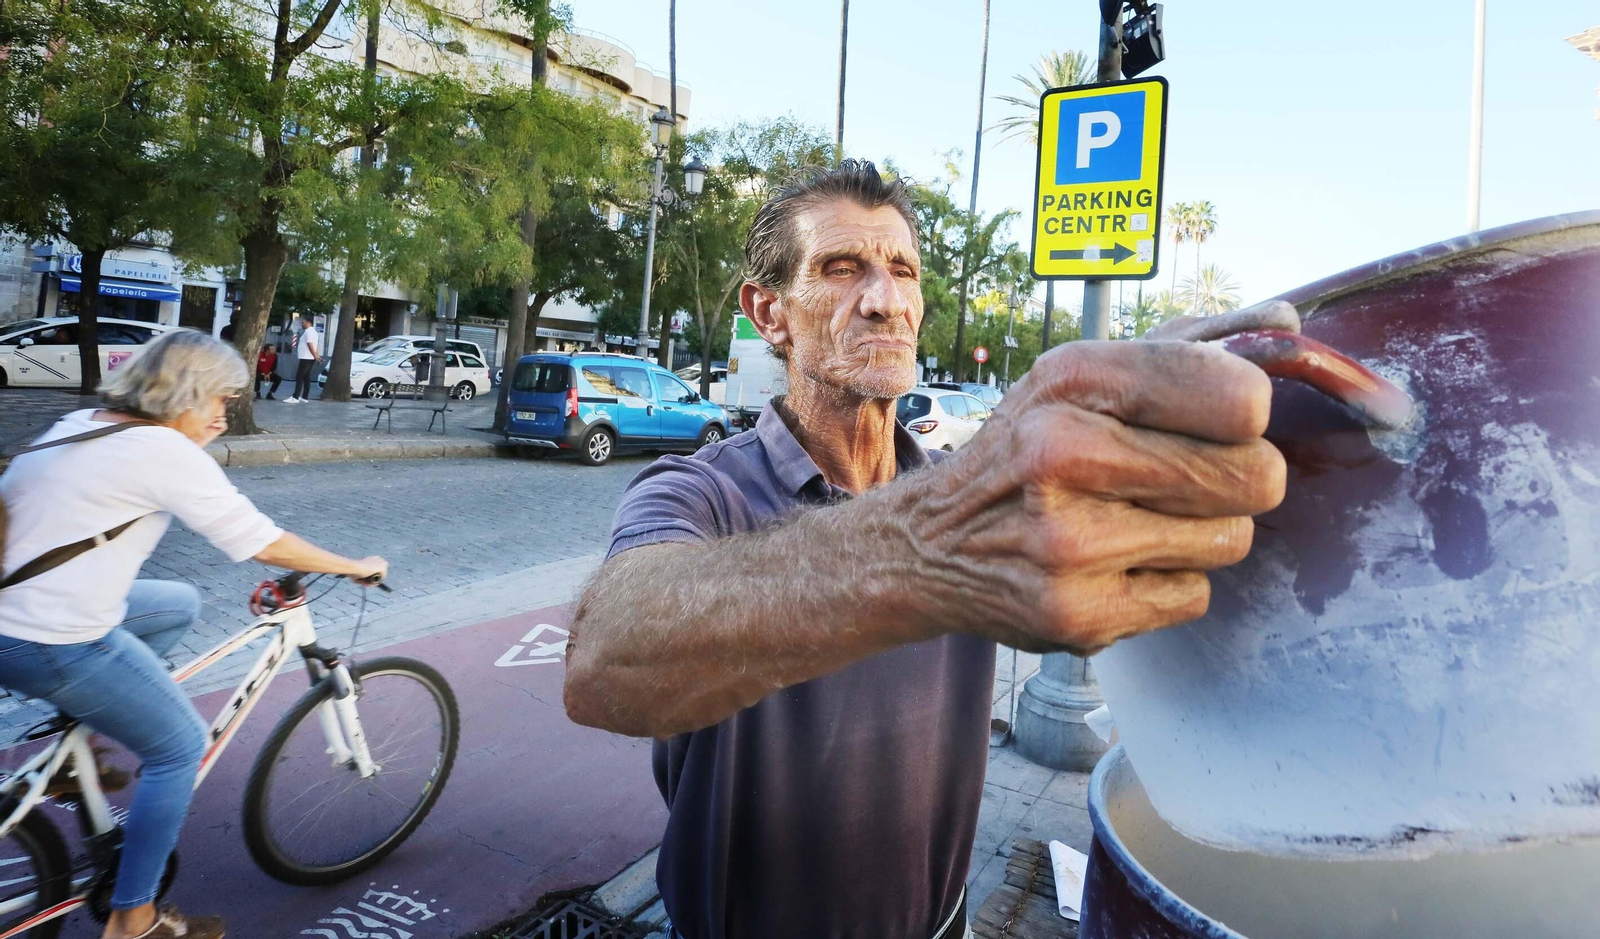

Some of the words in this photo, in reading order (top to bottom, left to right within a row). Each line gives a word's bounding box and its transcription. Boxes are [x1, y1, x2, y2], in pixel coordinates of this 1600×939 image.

[1076, 110, 1121, 169] P
[1042, 188, 1153, 212] PARKING
[1044, 214, 1147, 235] CENTR
